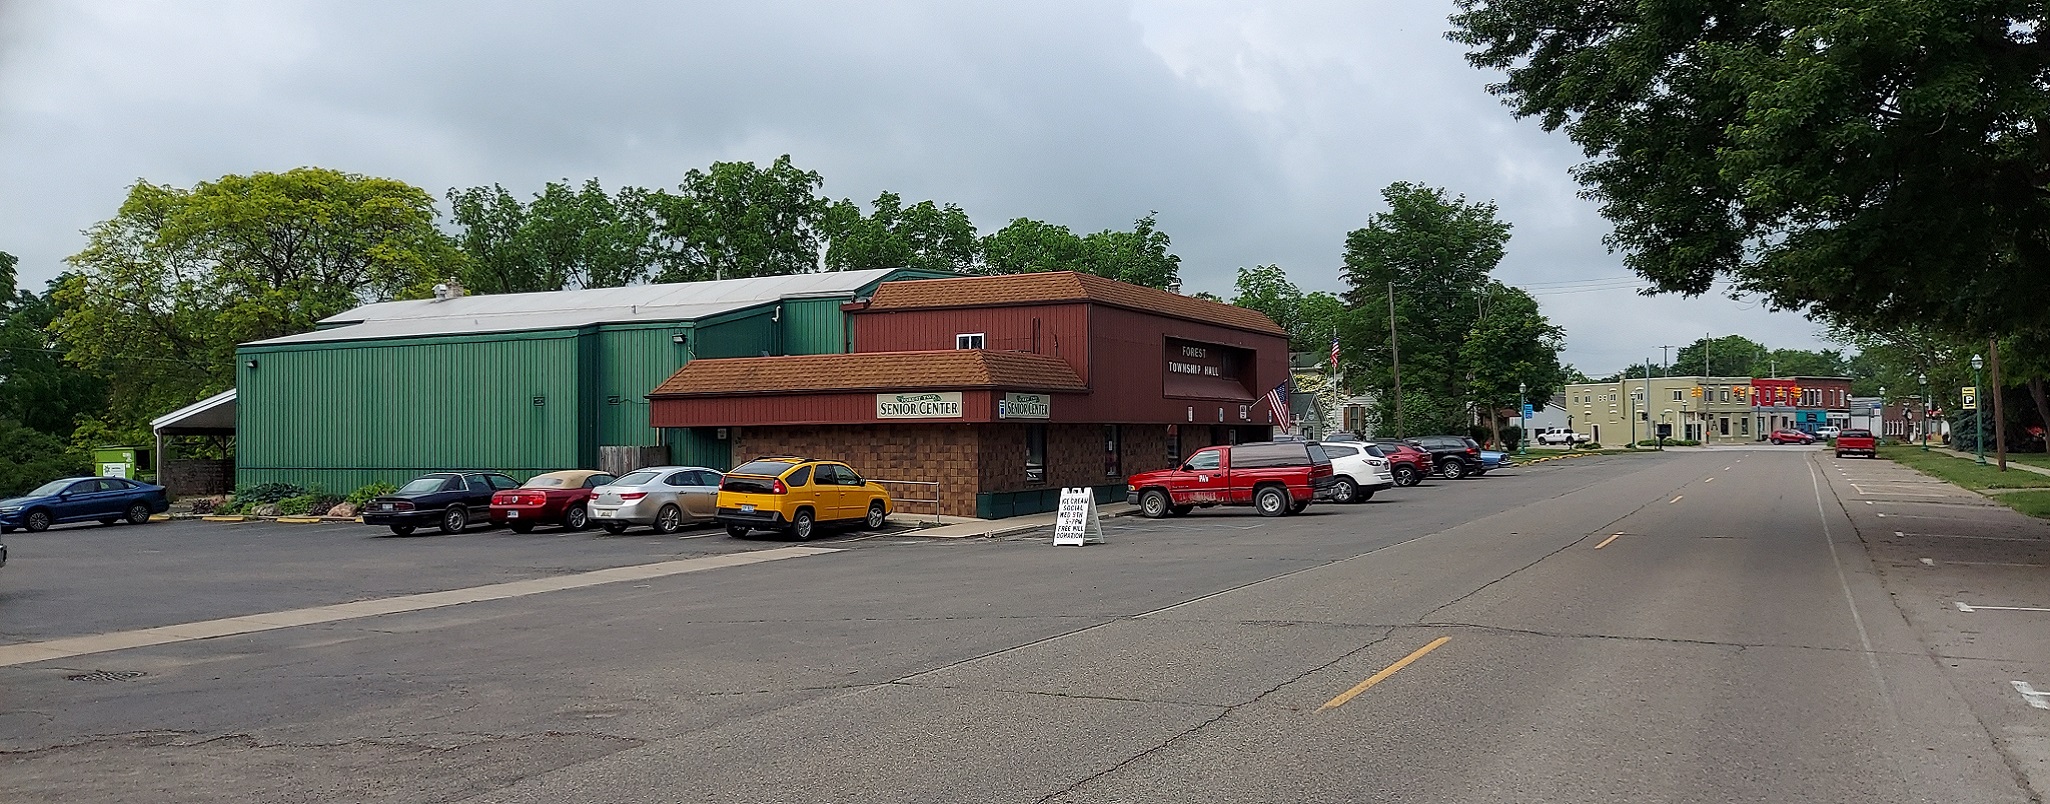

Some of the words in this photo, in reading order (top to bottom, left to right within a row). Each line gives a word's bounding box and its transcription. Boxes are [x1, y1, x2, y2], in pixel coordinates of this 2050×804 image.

[1182, 346, 1205, 358] FOREST
[1169, 362, 1200, 375] TOWNSHIP
[1204, 365, 1219, 377] HALL
[880, 402, 917, 416] SENIOR
[919, 401, 958, 415] CENTER
[1007, 401, 1027, 415] SENIOR
[1028, 402, 1048, 416] CENTER
